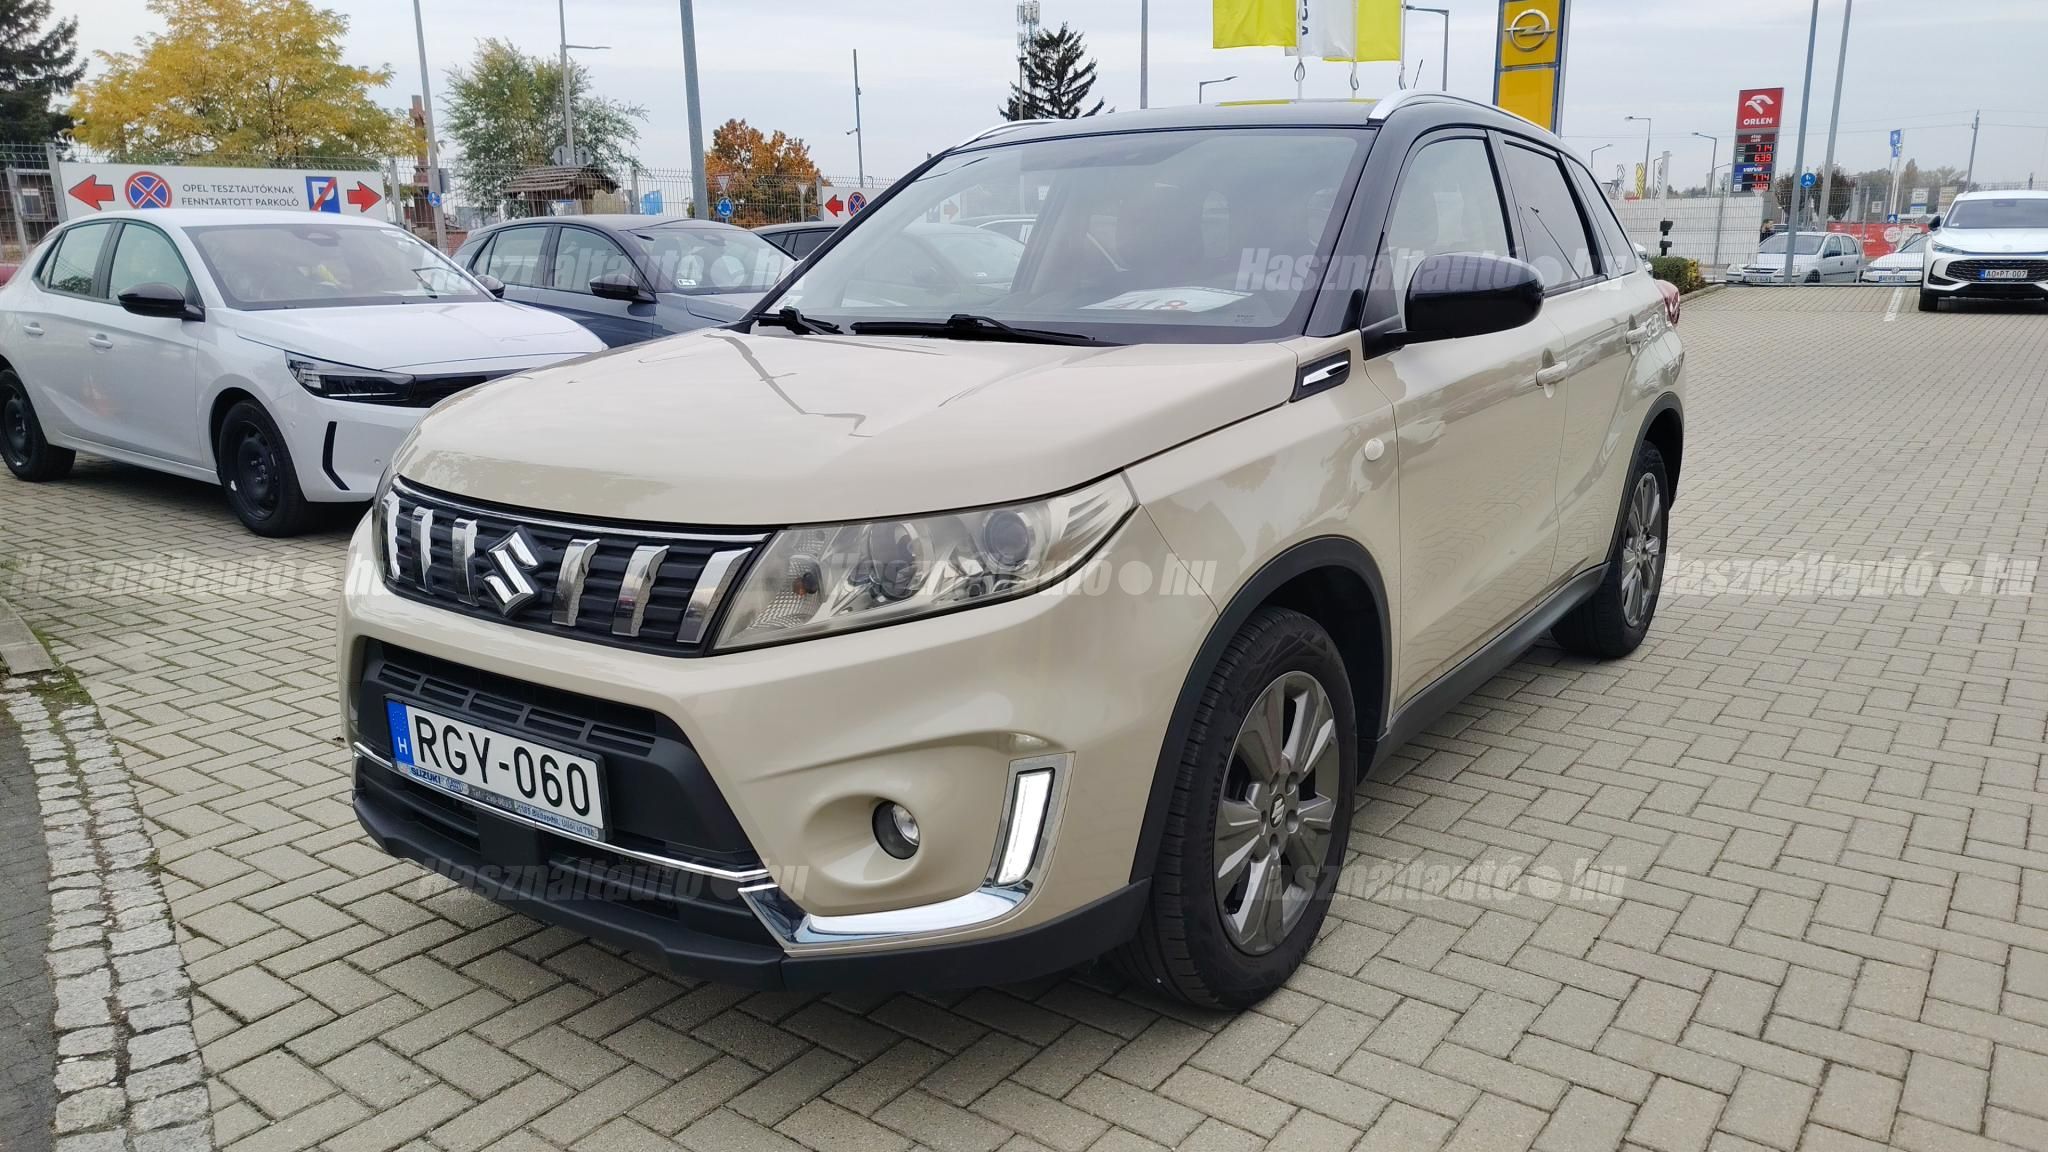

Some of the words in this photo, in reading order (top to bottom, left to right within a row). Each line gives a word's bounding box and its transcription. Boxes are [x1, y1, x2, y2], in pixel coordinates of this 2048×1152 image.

[1743, 117, 1773, 126] ORLEN
[1754, 153, 1772, 162] 639
[182, 183, 208, 193] OPEL
[210, 184, 295, 194] TESZTAUTÓKNAK
[181, 197, 252, 207] FENNTARTOTT
[255, 198, 300, 207] PARKOLÓ
[397, 735, 409, 755] H
[414, 714, 590, 817] RGY-060
[410, 767, 442, 785] SUZUKI
